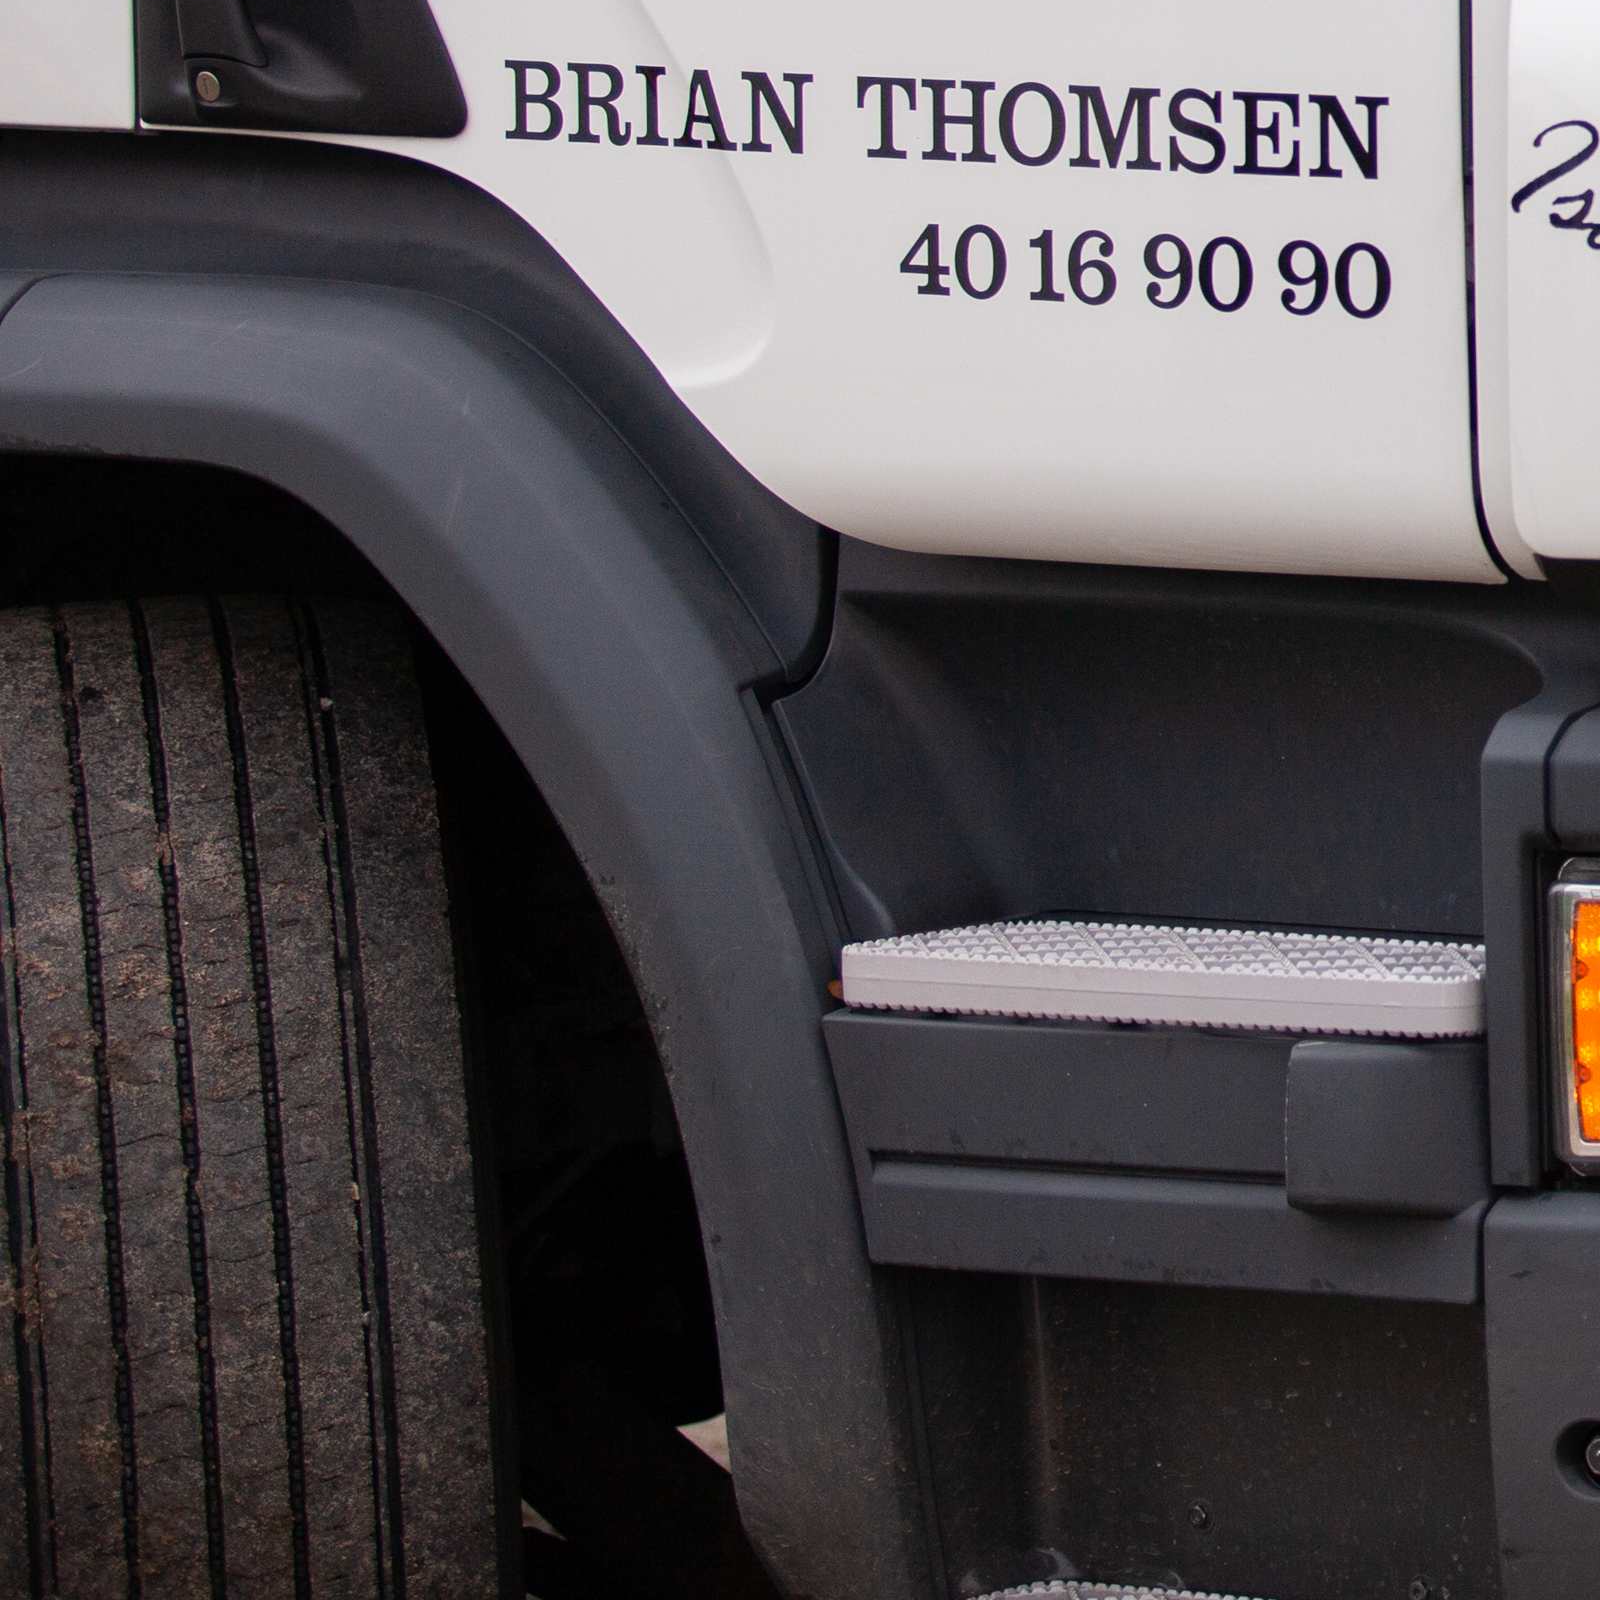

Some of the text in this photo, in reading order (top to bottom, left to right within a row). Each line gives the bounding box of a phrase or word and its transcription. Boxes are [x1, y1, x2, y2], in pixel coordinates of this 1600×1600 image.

[505, 60, 1390, 180] BRIAN THOMSEN
[900, 223, 1393, 320] 40 16 90 90
